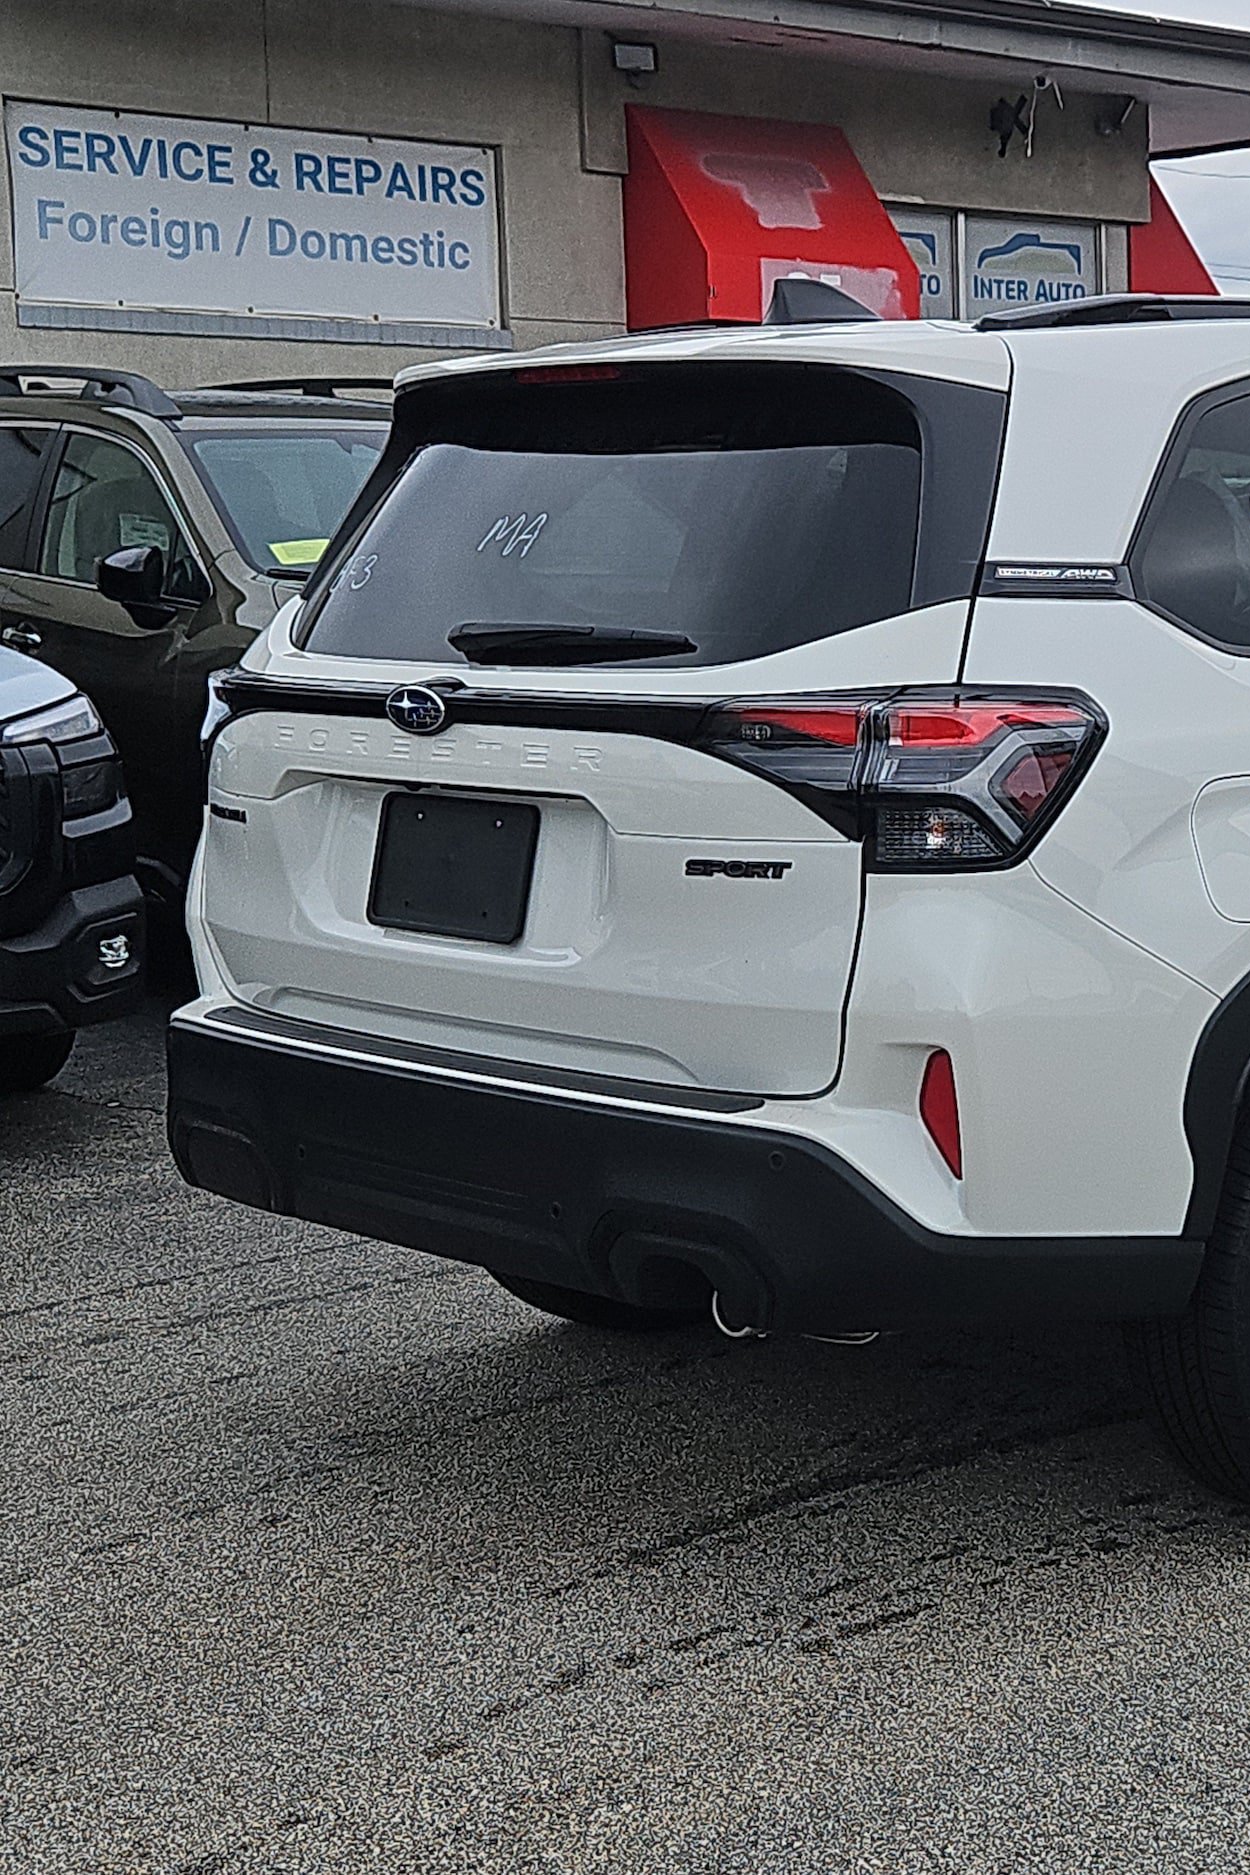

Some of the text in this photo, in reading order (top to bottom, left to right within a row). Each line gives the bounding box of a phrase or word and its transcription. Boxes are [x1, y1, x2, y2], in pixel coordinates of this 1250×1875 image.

[17, 125, 486, 207] SERVICE & REPAIRS
[36, 199, 471, 271] Foreign / Domestic
[919, 273, 941, 296] TO
[973, 274, 1086, 302] INTER AUTO
[477, 512, 548, 558] MA
[1058, 567, 1117, 581] AWD
[274, 725, 603, 772] FORESTER
[685, 858, 793, 880] SPORT
